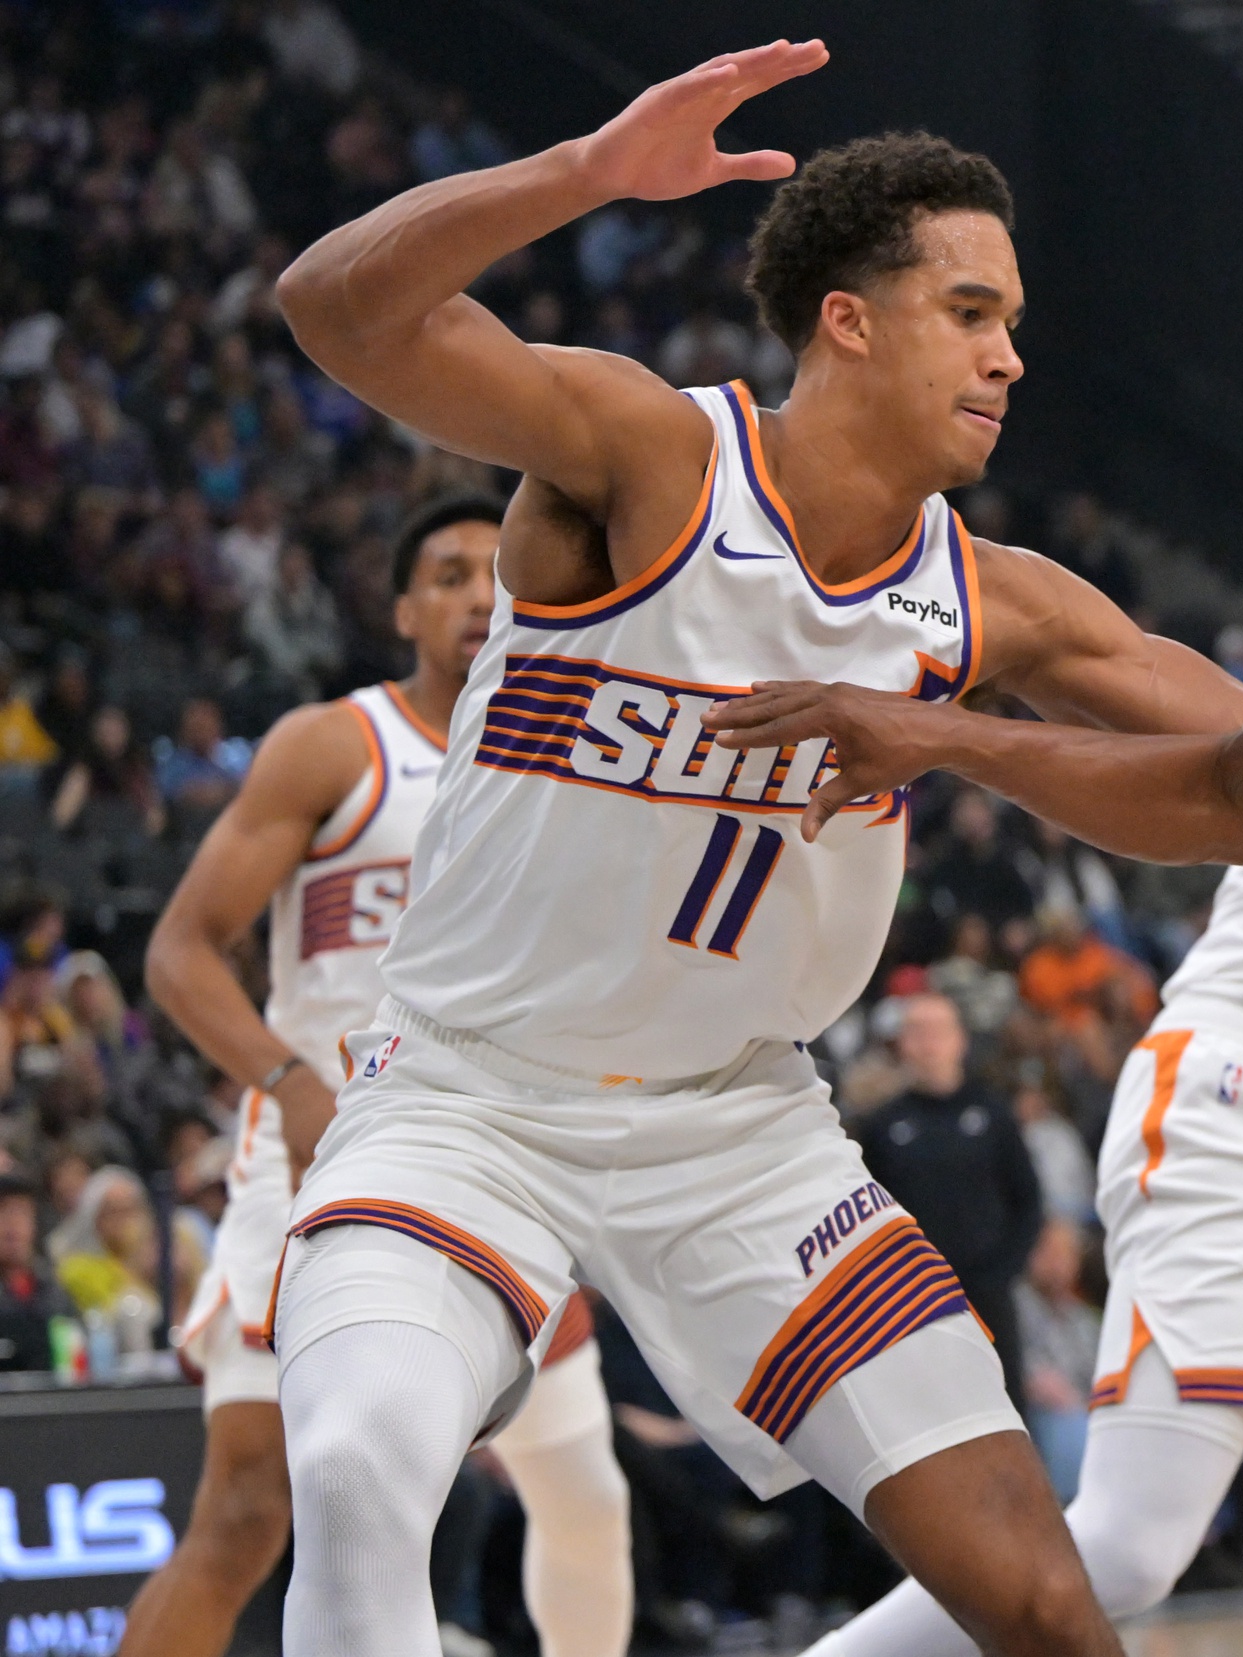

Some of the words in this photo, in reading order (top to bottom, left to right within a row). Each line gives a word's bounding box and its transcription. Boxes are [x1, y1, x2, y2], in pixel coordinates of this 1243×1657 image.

[887, 592, 957, 629] PayPal
[570, 680, 873, 804] SUN
[667, 812, 786, 961] 11
